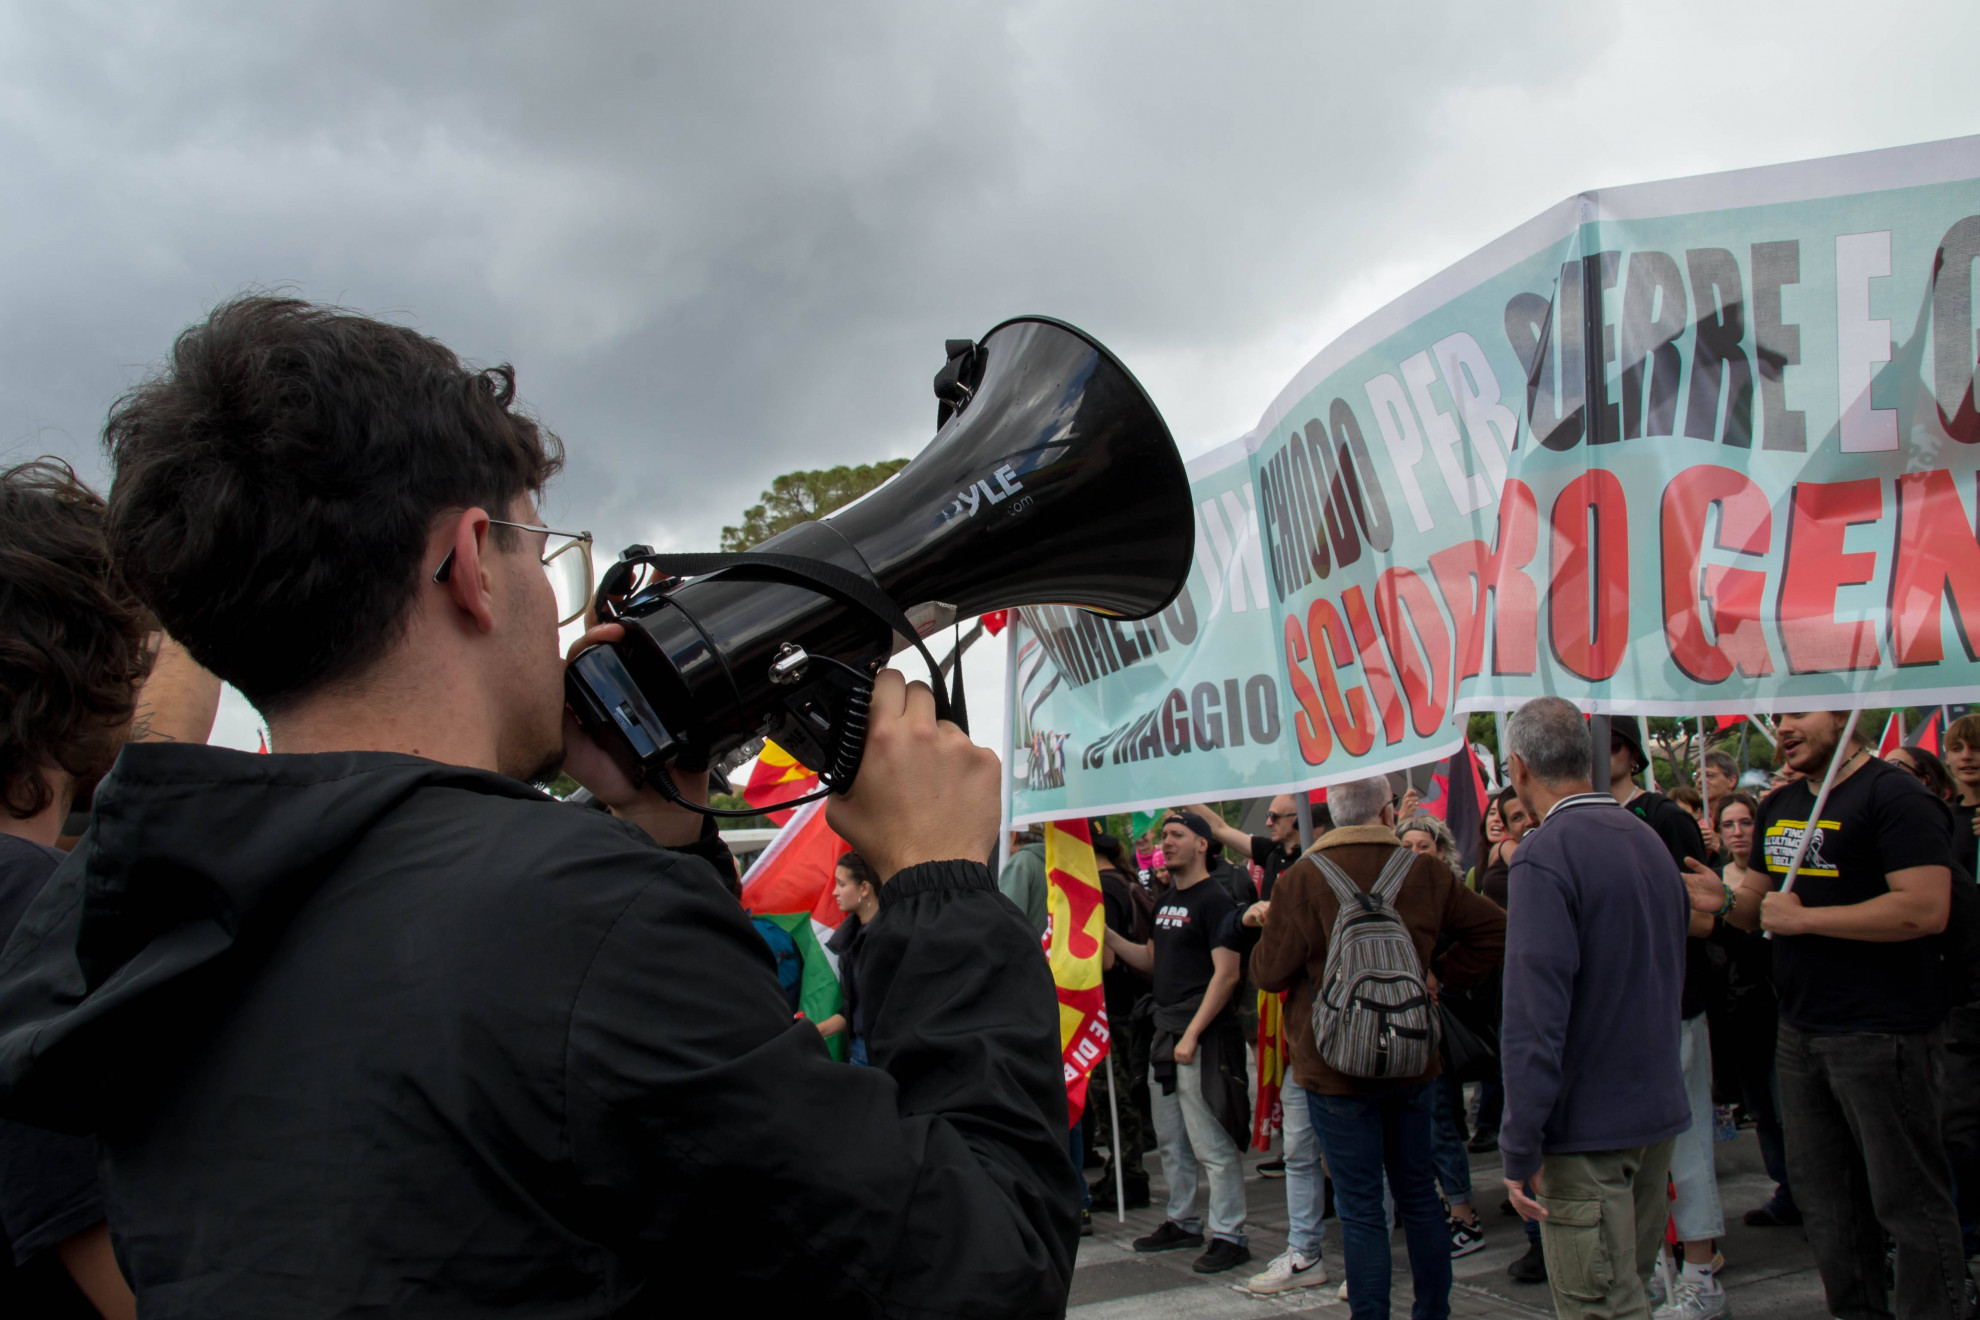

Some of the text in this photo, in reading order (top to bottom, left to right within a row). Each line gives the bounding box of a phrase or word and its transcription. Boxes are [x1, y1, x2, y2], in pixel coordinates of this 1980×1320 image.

[1194, 481, 1271, 624] UN
[1261, 398, 1394, 604] CHIODO
[1364, 331, 1518, 534] PER
[1835, 230, 1900, 454] E
[1112, 673, 1281, 765] MAGGIO
[1284, 468, 1630, 766] SCIOPRO
[1072, 1037, 1100, 1068] DI
